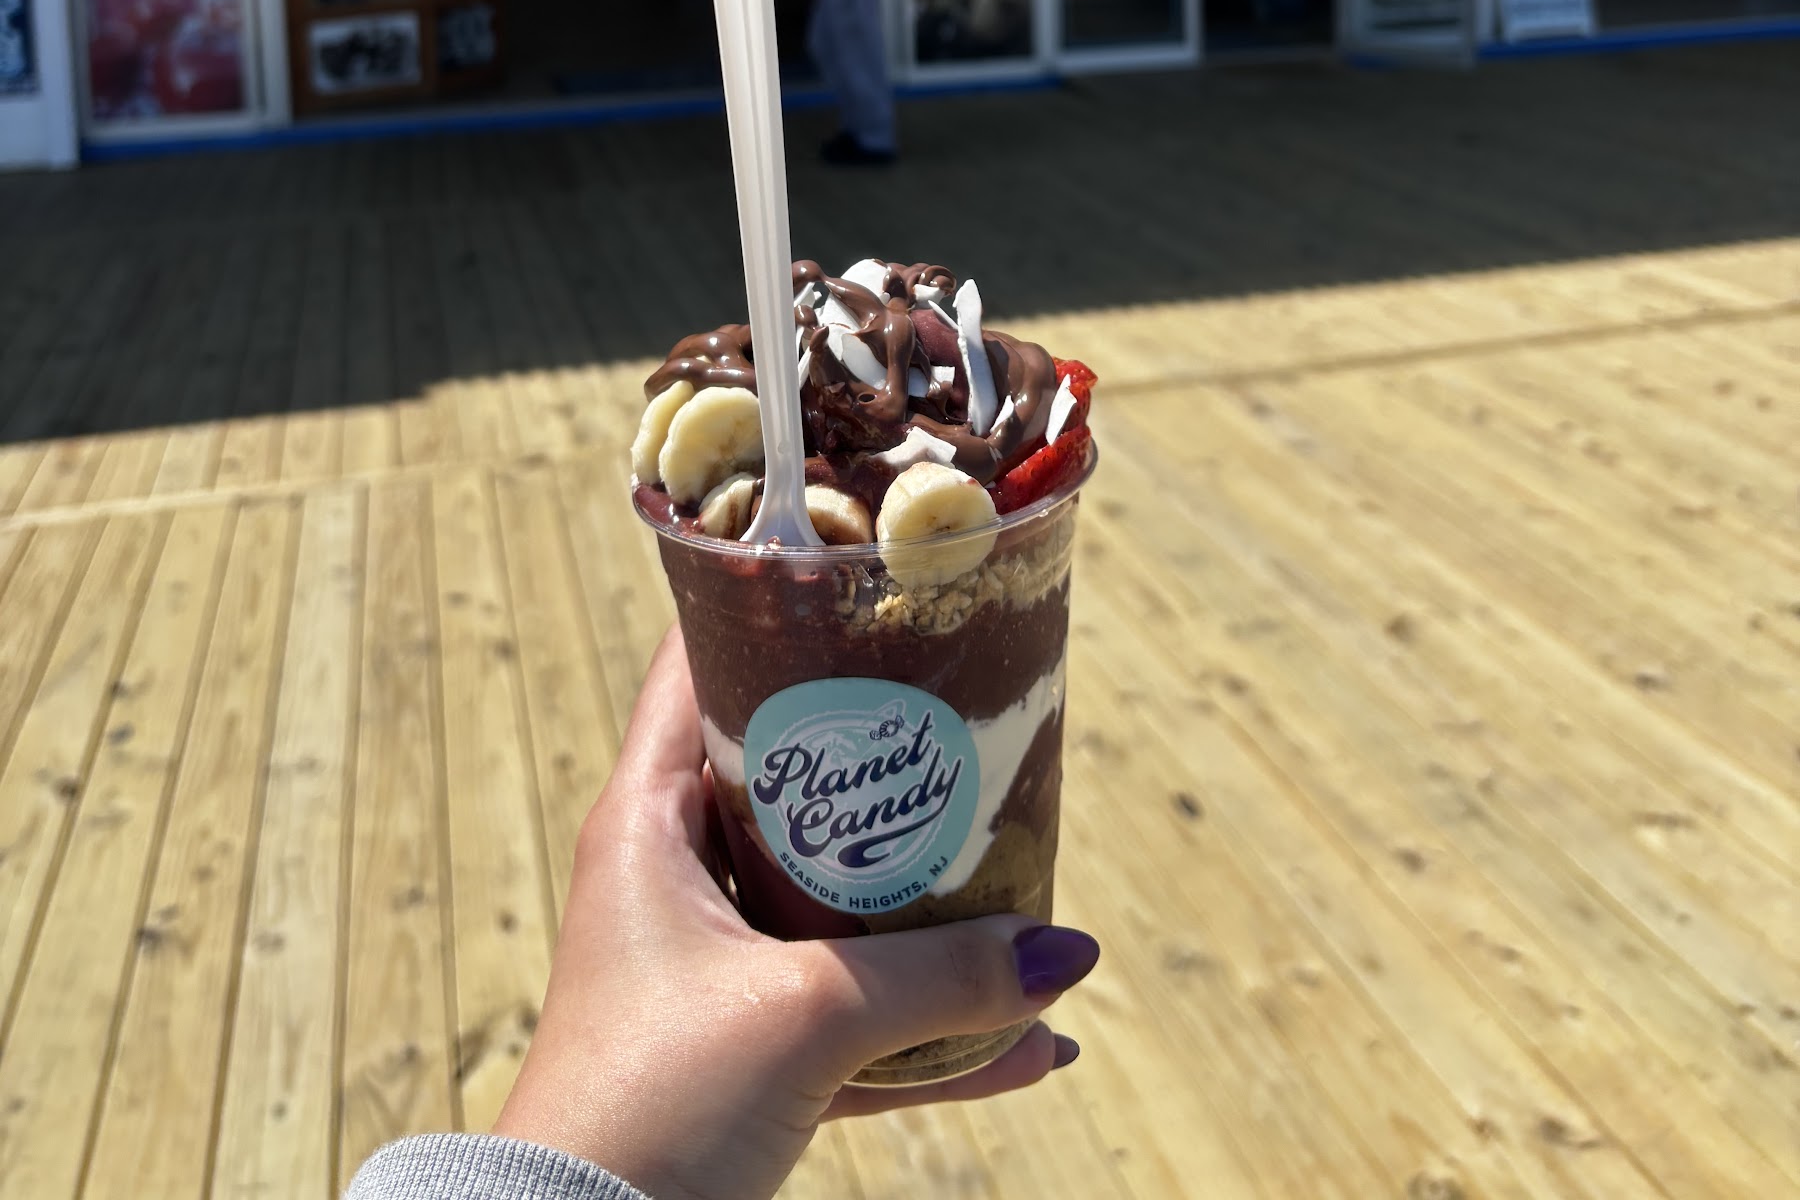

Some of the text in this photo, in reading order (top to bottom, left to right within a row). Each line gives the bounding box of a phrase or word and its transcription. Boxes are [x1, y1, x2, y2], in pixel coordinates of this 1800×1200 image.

[752, 711, 934, 804] Planet
[787, 746, 963, 868] Candy
[779, 851, 949, 909] SEASIDE HEIGHTS, NJ
